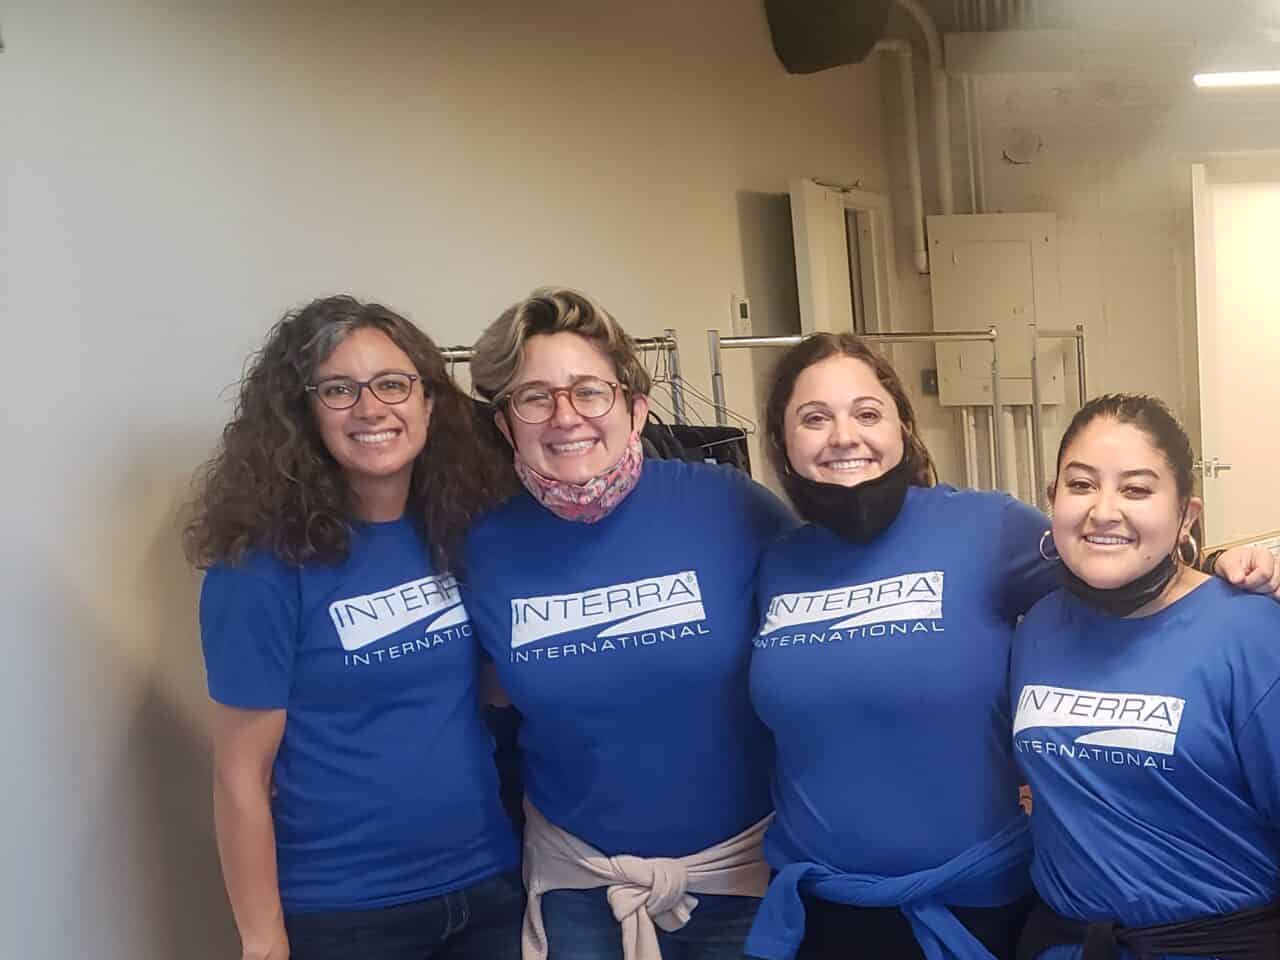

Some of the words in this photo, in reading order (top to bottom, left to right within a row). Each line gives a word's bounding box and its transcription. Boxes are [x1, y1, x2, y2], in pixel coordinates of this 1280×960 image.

[514, 578, 695, 625] INTERRA
[344, 624, 473, 667] INTERNATIO
[509, 623, 711, 663] INTERNATIONAL
